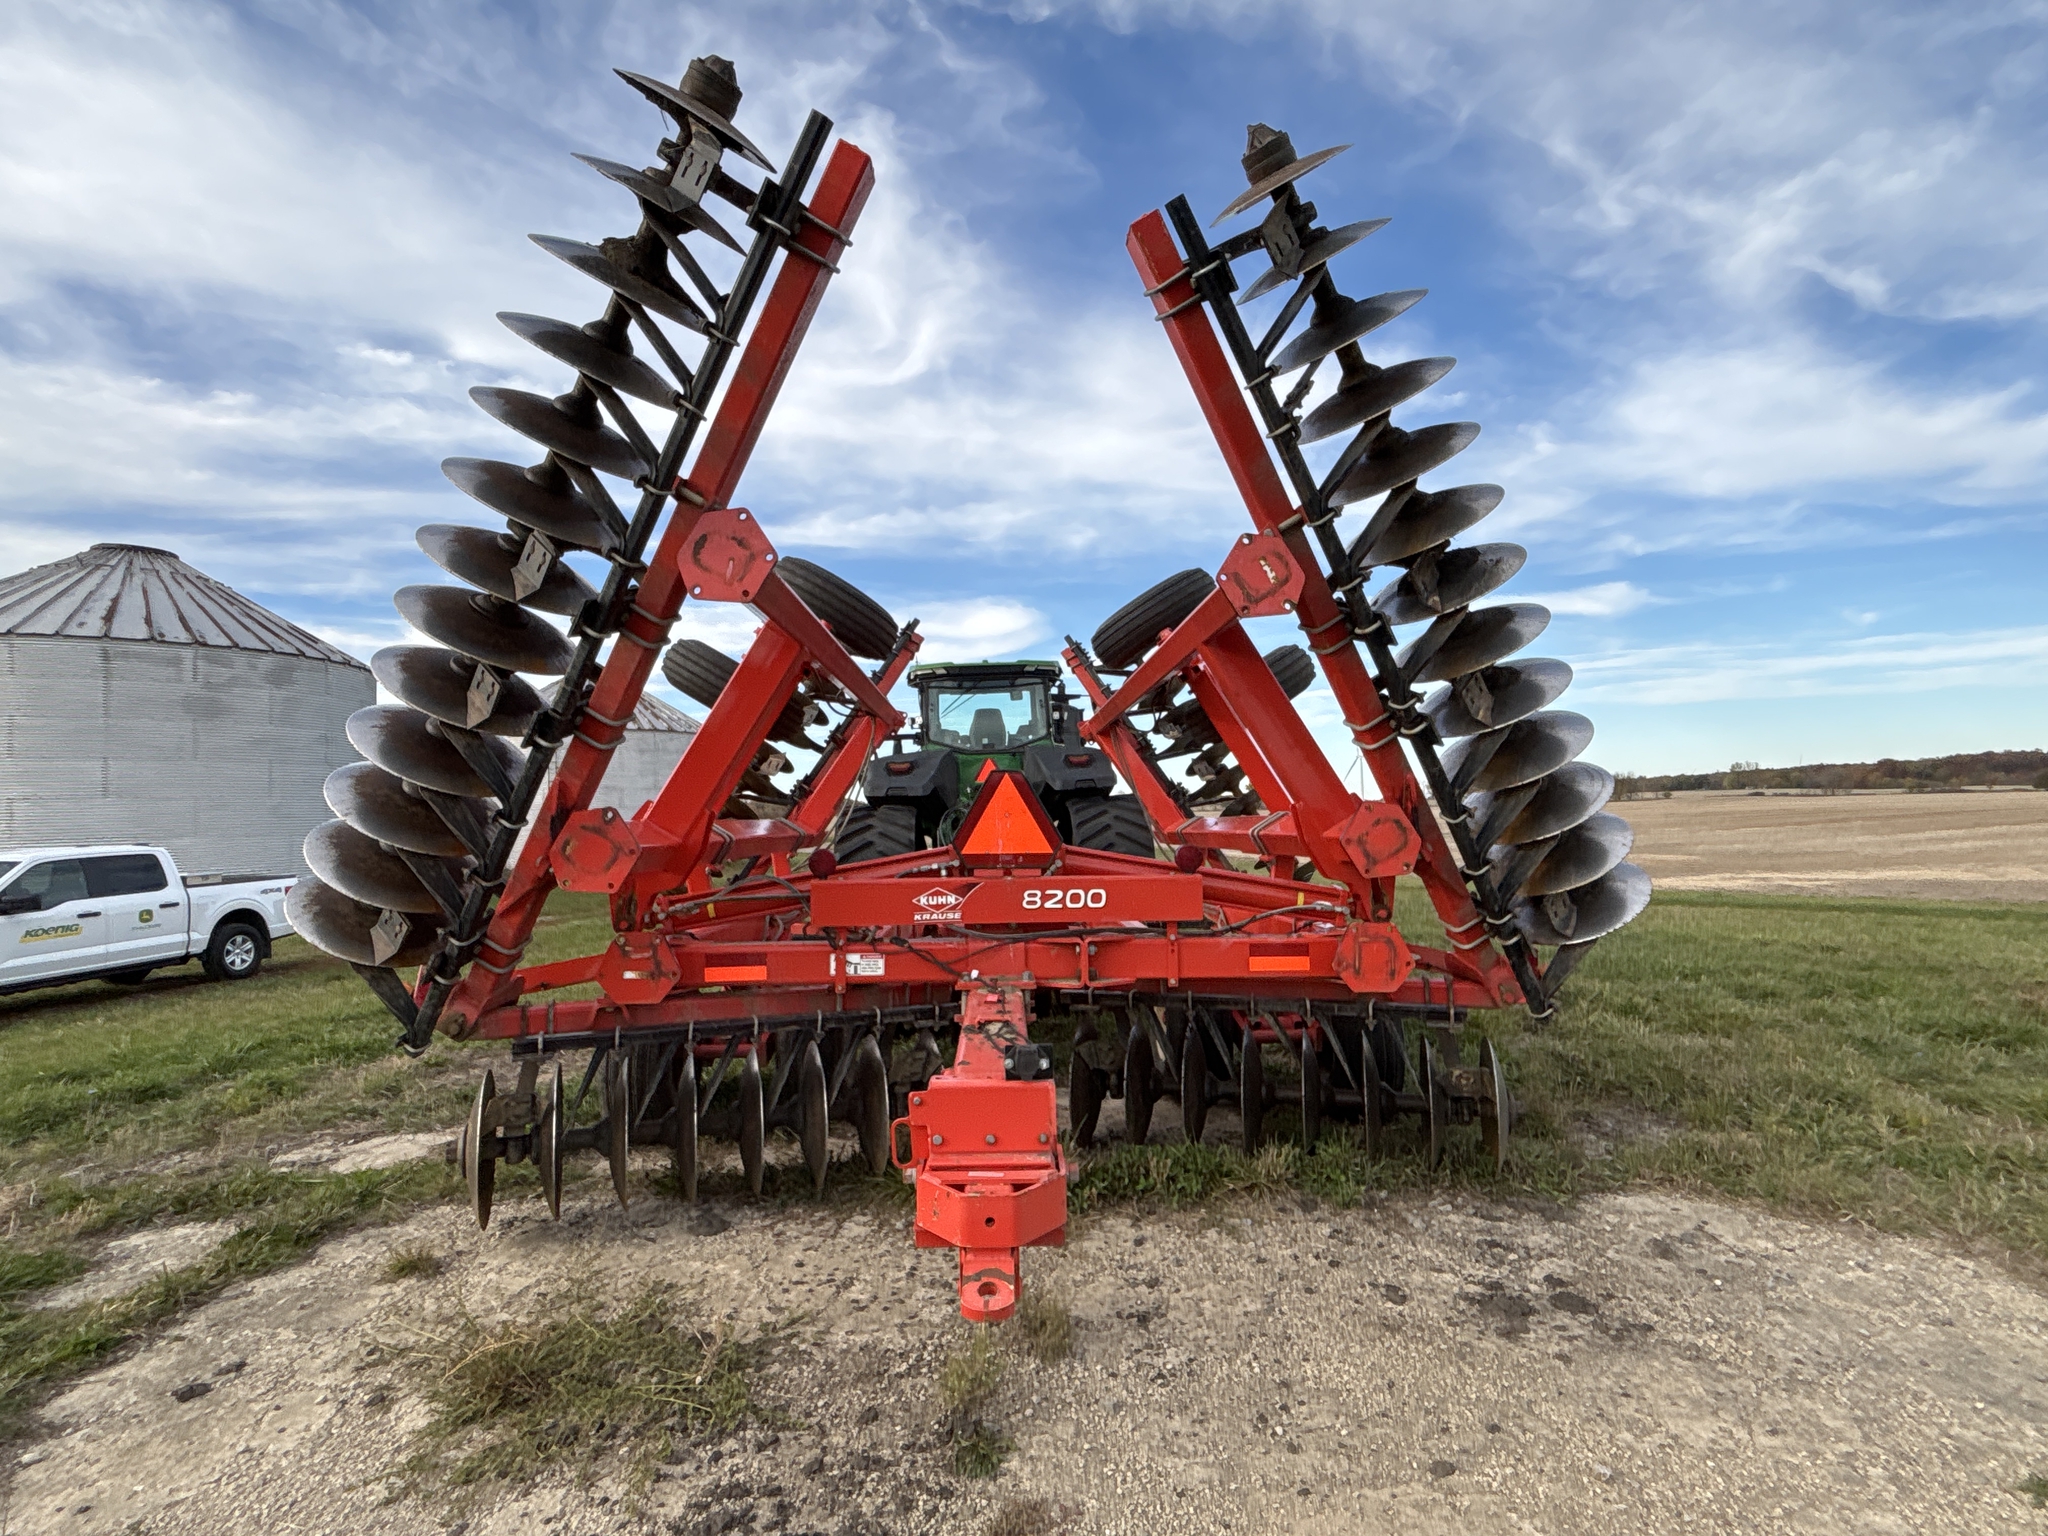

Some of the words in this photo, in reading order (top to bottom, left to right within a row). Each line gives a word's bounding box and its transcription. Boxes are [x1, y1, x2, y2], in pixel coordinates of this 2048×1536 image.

[920, 895, 956, 906] KUHN
[1022, 888, 1107, 910] 8200
[913, 911, 962, 921] KRAUSE
